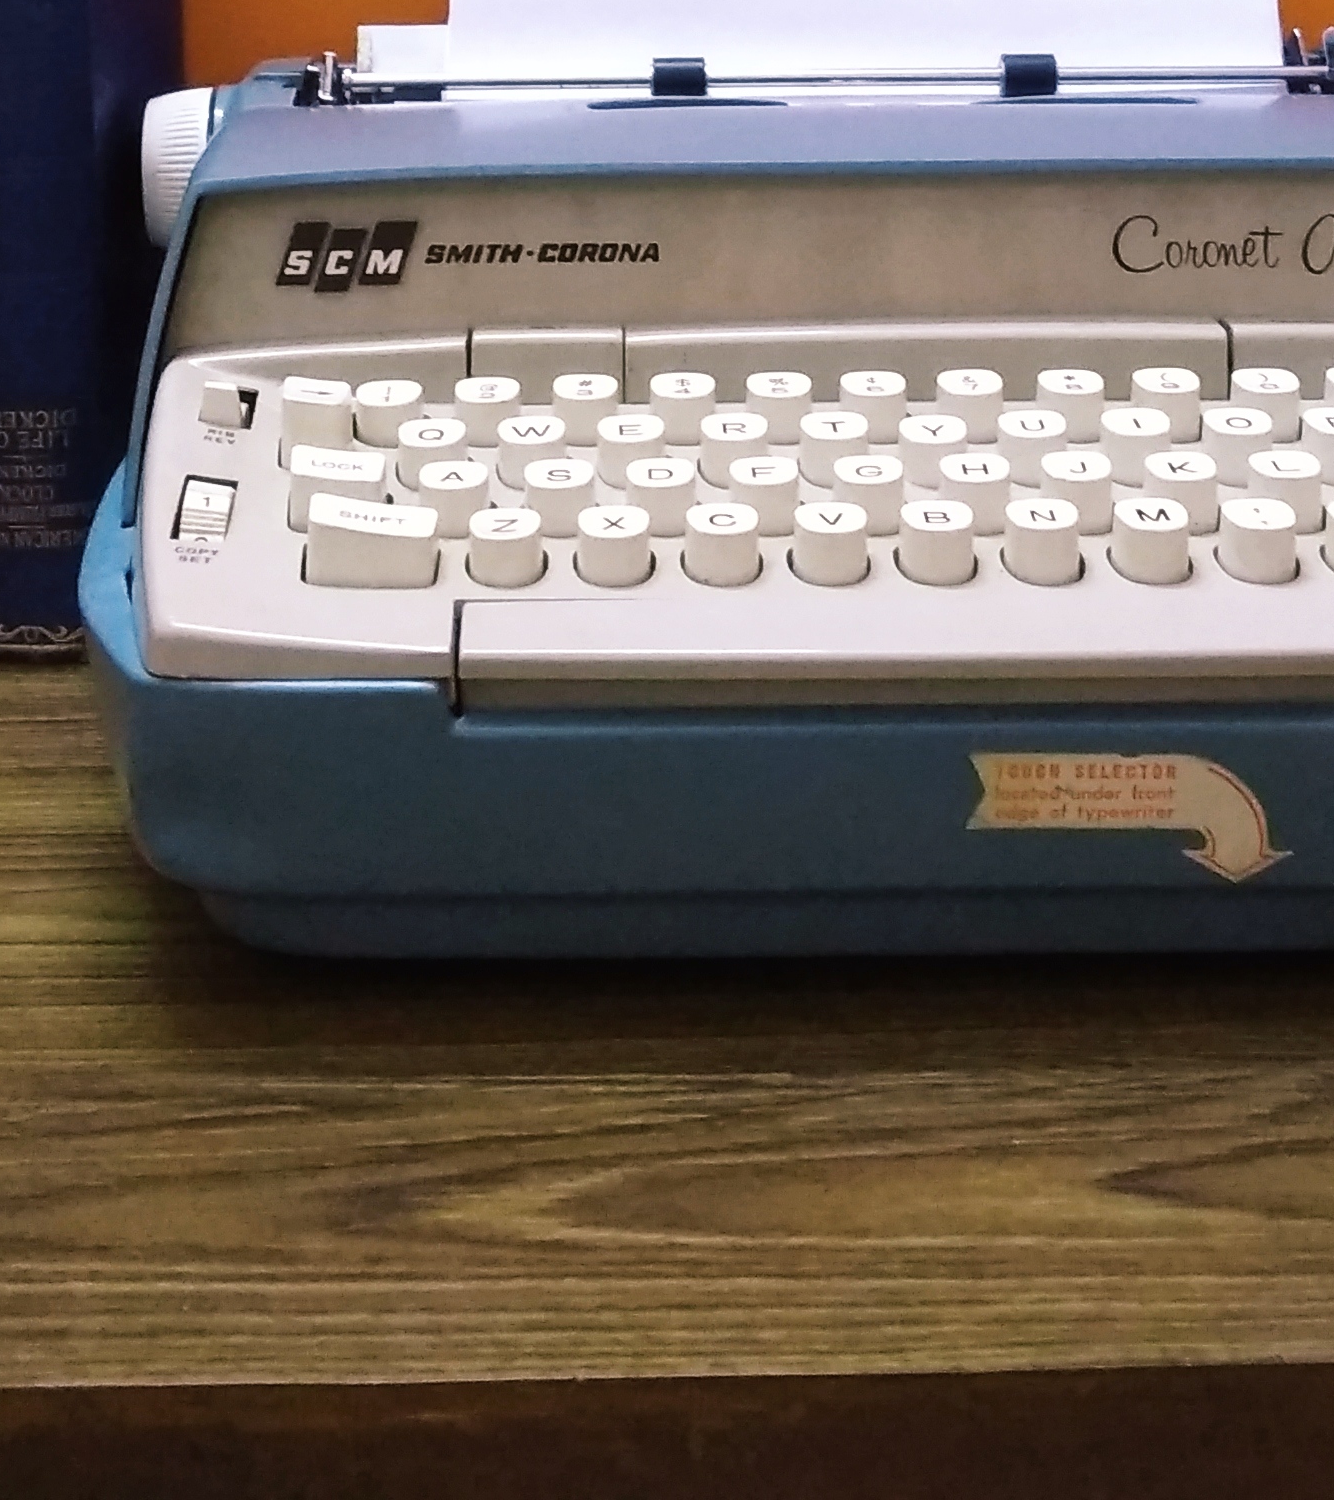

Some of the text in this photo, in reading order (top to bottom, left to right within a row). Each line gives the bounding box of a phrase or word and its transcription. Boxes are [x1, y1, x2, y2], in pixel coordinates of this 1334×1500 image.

[1112, 214, 1284, 274] Coronet
[283, 249, 403, 276] SCM
[722, 422, 747, 435] R
[821, 420, 846, 433] T
[1020, 419, 1045, 432] U
[1133, 418, 1142, 429] I
[1225, 416, 1253, 429] O
[418, 428, 445, 440] Q
[511, 424, 551, 437] W
[618, 424, 643, 436] E
[921, 423, 945, 436] Y
[15, 430, 68, 449] LIFE
[311, 460, 364, 471] LOCK
[751, 466, 776, 478] F
[854, 465, 883, 478] G
[961, 463, 989, 476] H
[1070, 461, 1087, 474] J
[1167, 461, 1198, 474] K
[1271, 461, 1301, 472] L
[440, 472, 464, 483] A
[547, 469, 572, 482] S
[647, 468, 673, 480] D
[203, 497, 210, 507] 1
[339, 510, 407, 525] SHIFT
[708, 513, 737, 527] C
[819, 512, 843, 526] V
[923, 511, 951, 524] B
[1030, 509, 1057, 522] N
[1135, 508, 1171, 522] M
[492, 518, 519, 532] Z
[602, 516, 627, 530] X
[1075, 764, 1176, 779] SELECTOR
[1070, 786, 1122, 801] under
[1131, 785, 1175, 801] front
[1049, 804, 1067, 819] of
[1077, 805, 1175, 821] typewriter
